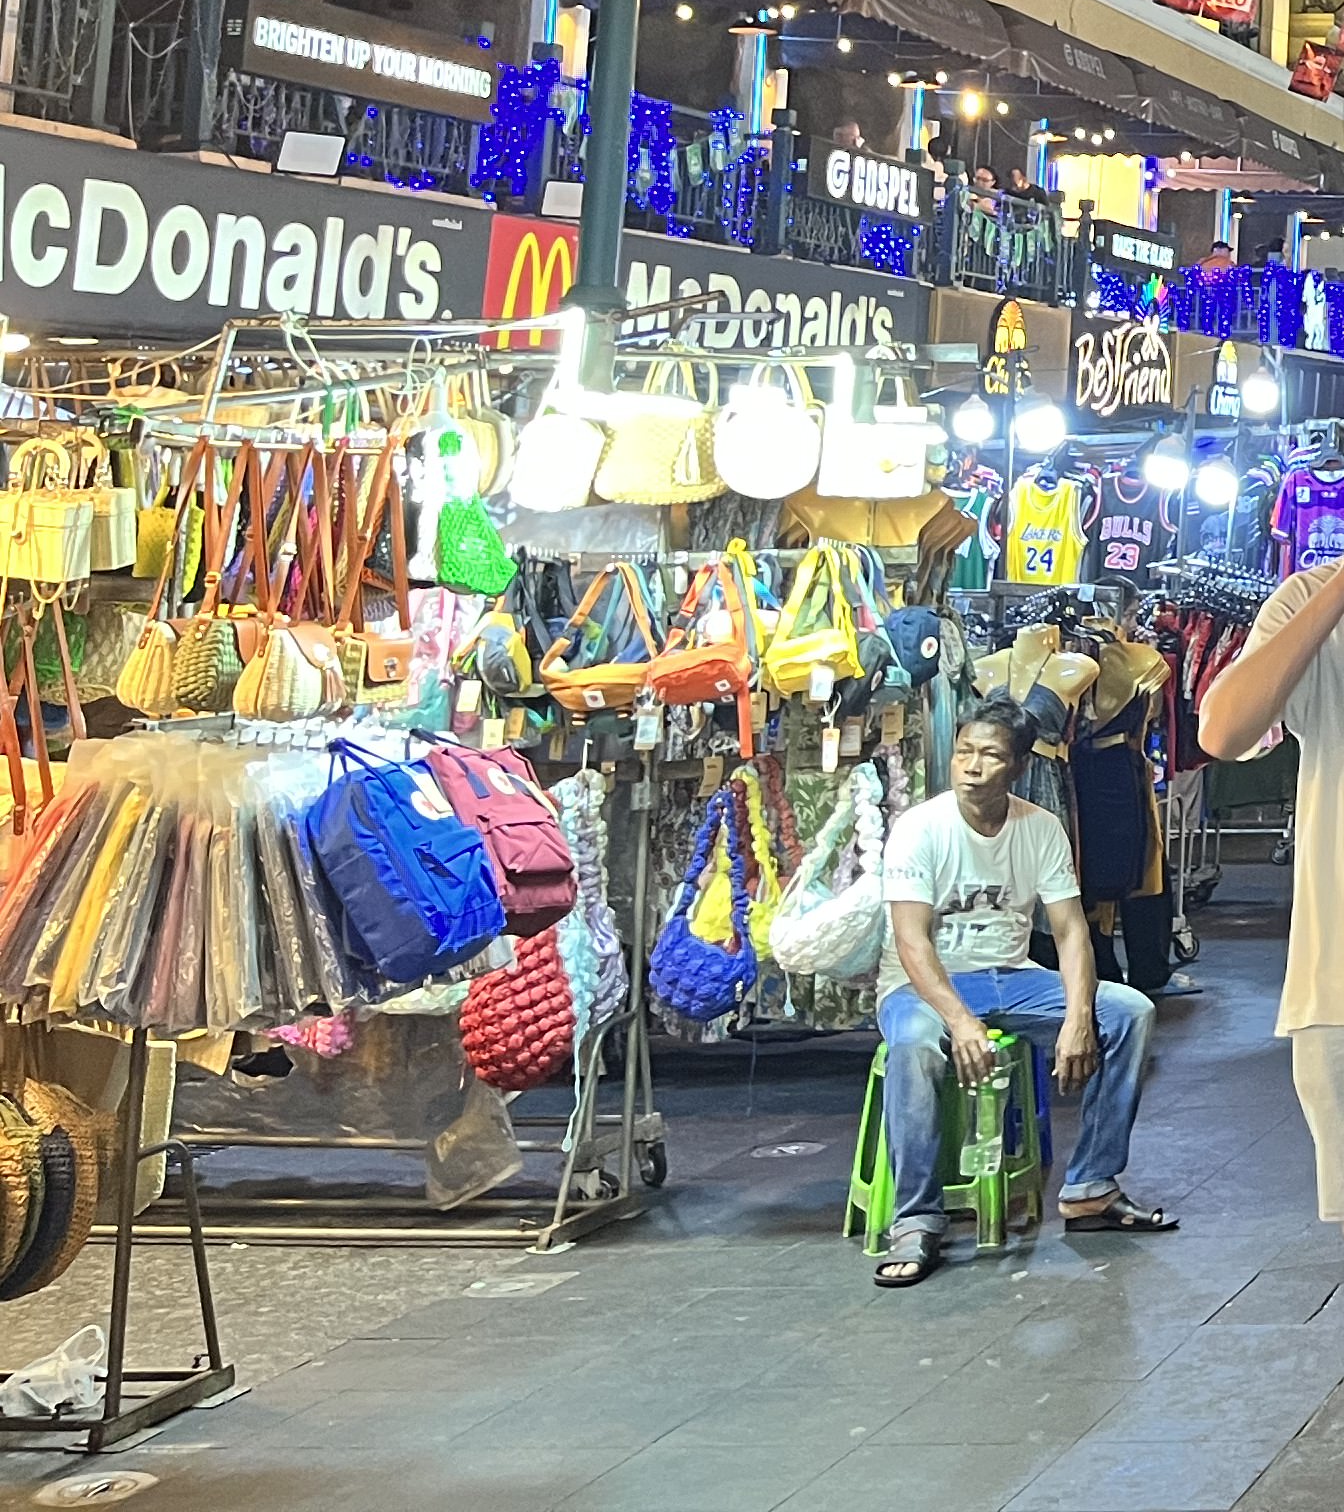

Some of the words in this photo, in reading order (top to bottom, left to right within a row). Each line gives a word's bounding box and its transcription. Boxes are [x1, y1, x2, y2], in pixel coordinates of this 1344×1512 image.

[253, 16, 346, 65] BRIGHTEN
[345, 38, 371, 70] UP
[372, 43, 417, 84] YOUR
[417, 55, 492, 99] MORNING
[851, 156, 920, 218] GOSPEL
[0, 164, 443, 322] cDonald's
[1100, 516, 1152, 546] BULLS
[1025, 548, 1054, 573] 24
[1104, 543, 1140, 570] 23
